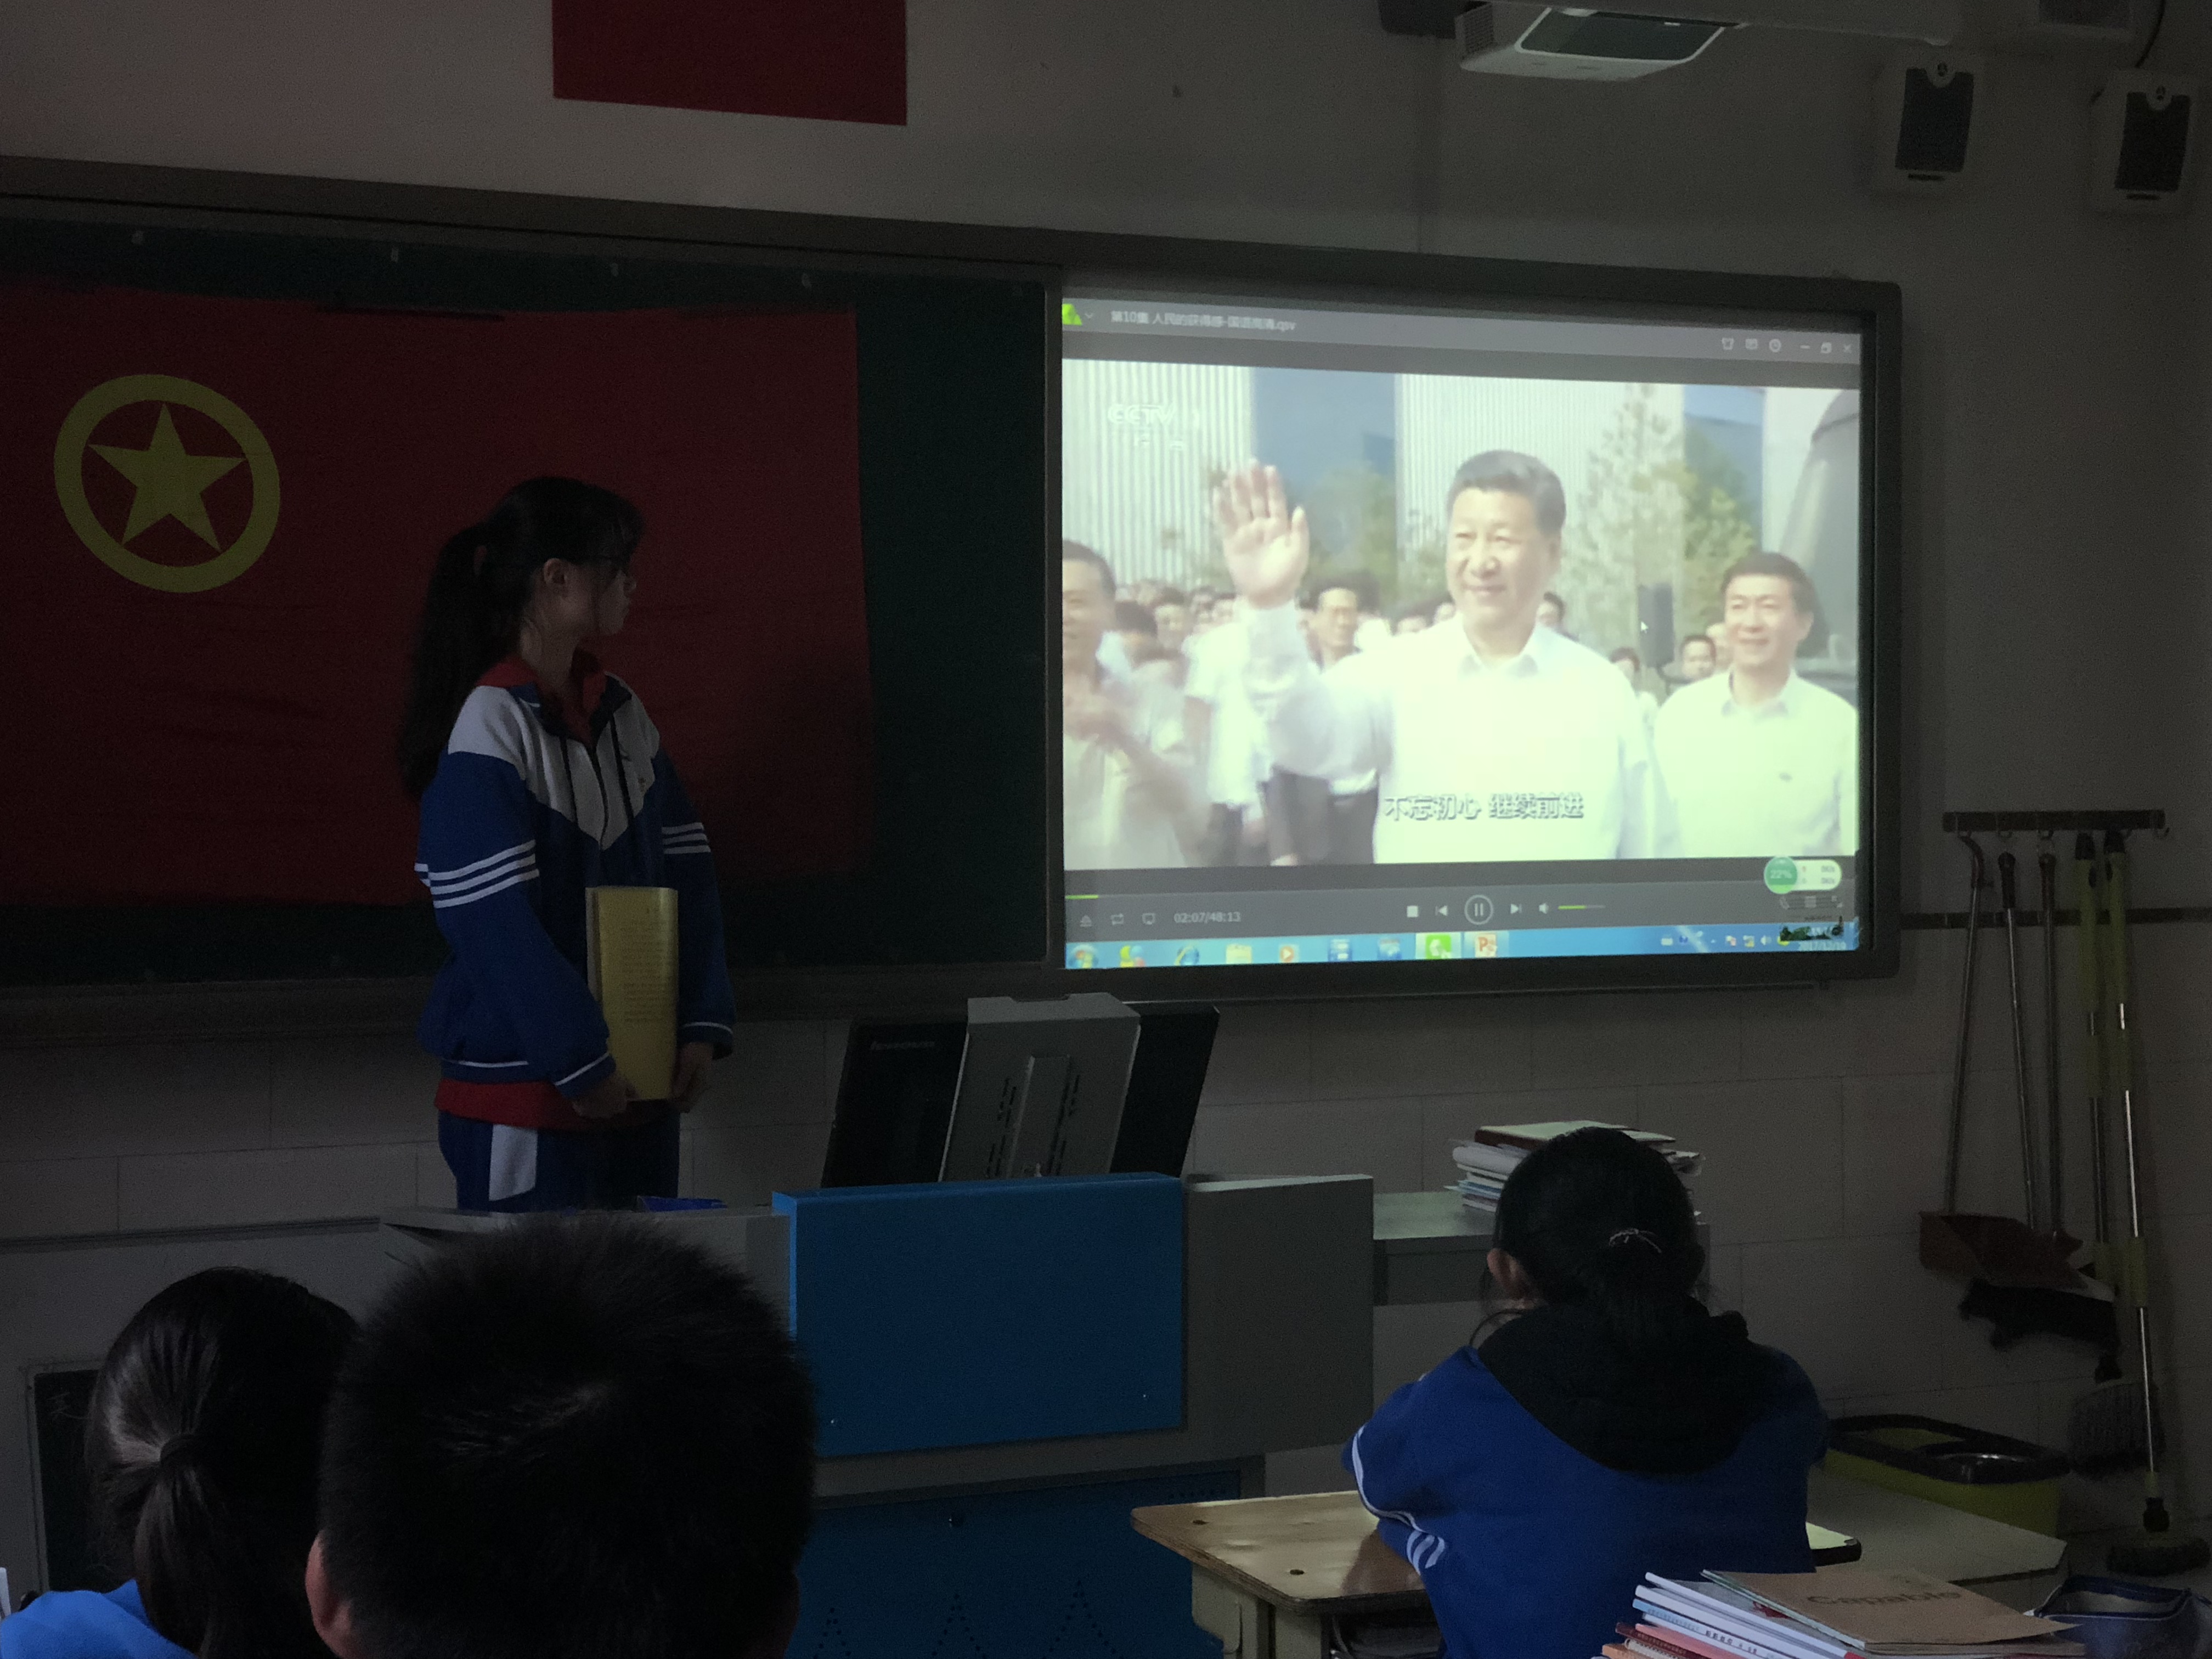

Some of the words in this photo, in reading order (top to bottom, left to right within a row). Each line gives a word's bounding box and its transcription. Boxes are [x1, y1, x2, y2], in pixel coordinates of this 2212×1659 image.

[1108, 404, 1176, 425] CCTV
[1385, 793, 1482, 821] 不忘初心
[1488, 792, 1584, 820] 继续前进
[1173, 911, 1241, 924] 02:07/48:13
[1807, 1592, 1962, 1605] Capable
